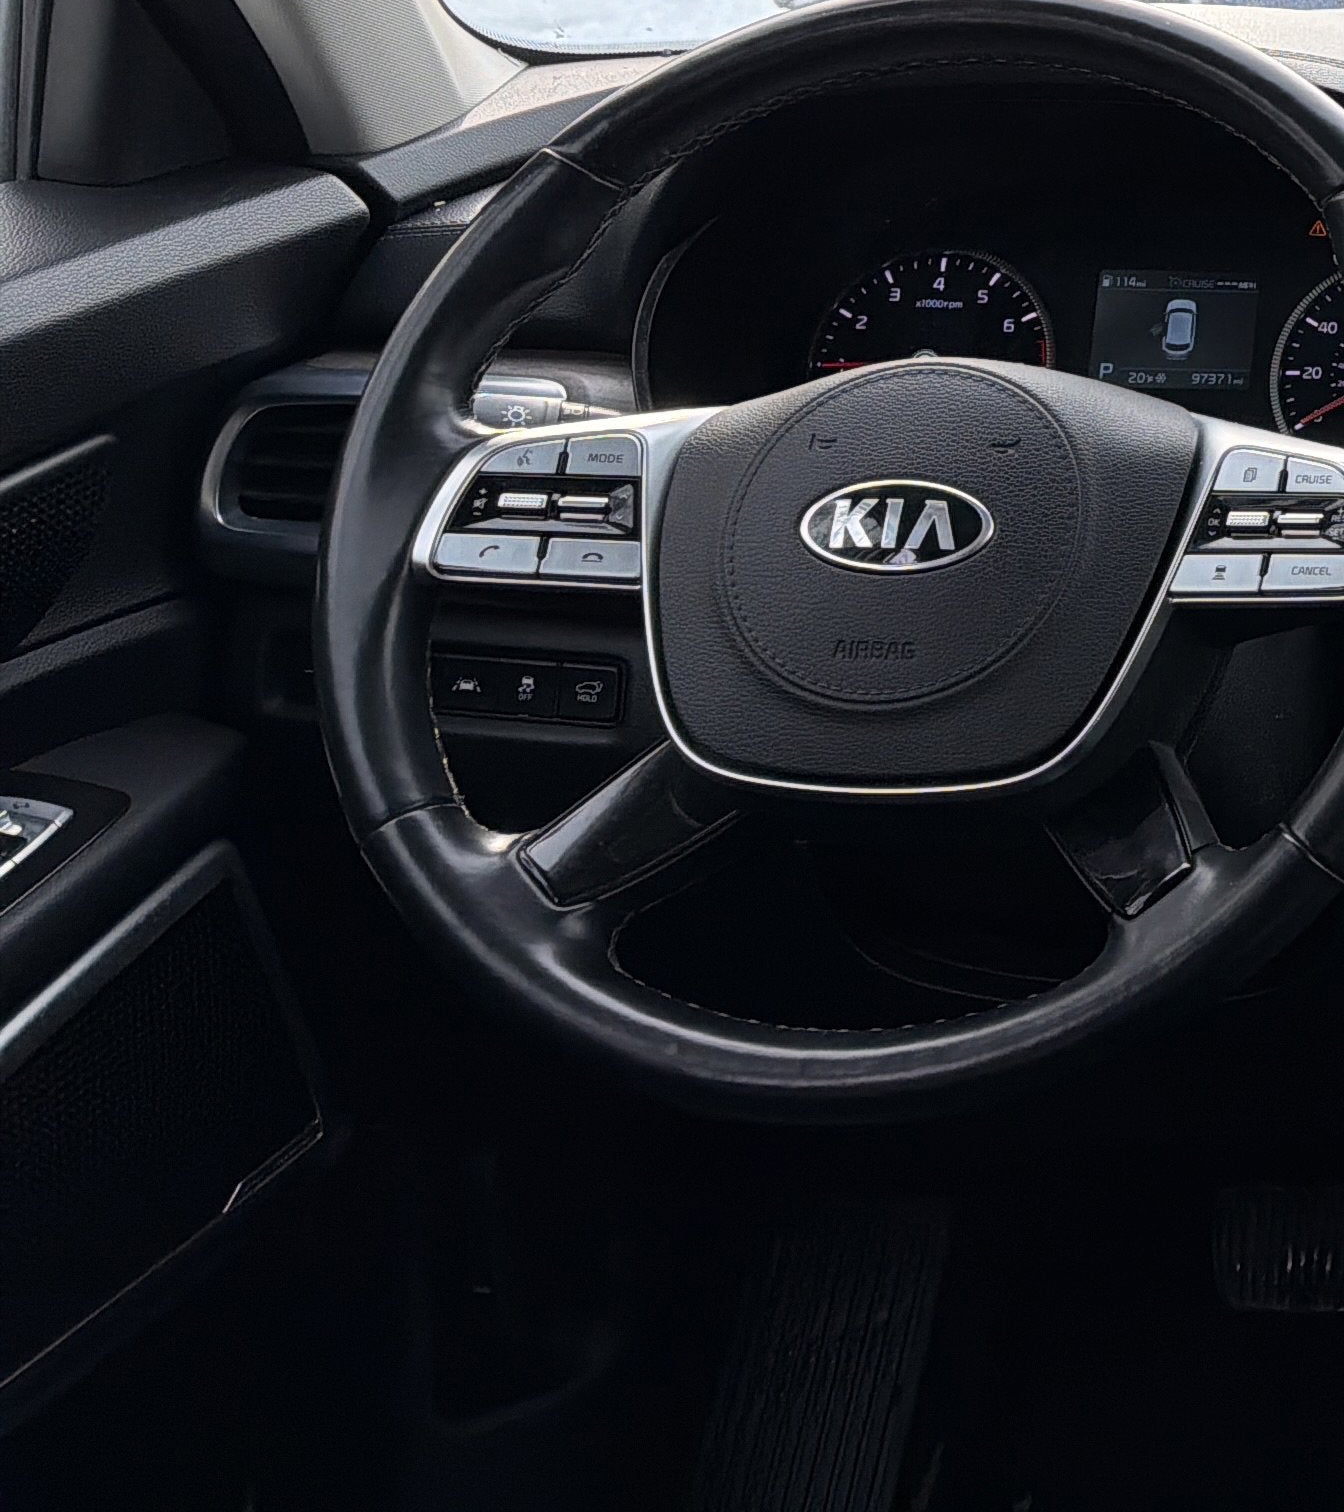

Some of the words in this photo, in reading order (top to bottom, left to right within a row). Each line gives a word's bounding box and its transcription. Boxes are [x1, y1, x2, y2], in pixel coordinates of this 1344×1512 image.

[932, 277, 945, 292] 4
[1182, 279, 1215, 289] CRUISE
[888, 288, 901, 302] 3
[977, 290, 989, 304] 5
[855, 316, 868, 330] 2
[1003, 319, 1015, 333] 6
[1318, 321, 1338, 335] 40
[1302, 366, 1322, 380] 20
[587, 453, 624, 464] MODE
[1295, 474, 1333, 485] CRUISE
[828, 498, 955, 551] KIA
[1207, 518, 1220, 526] OK
[1291, 565, 1332, 576] CANCEL
[832, 640, 917, 660] AIRBAG
